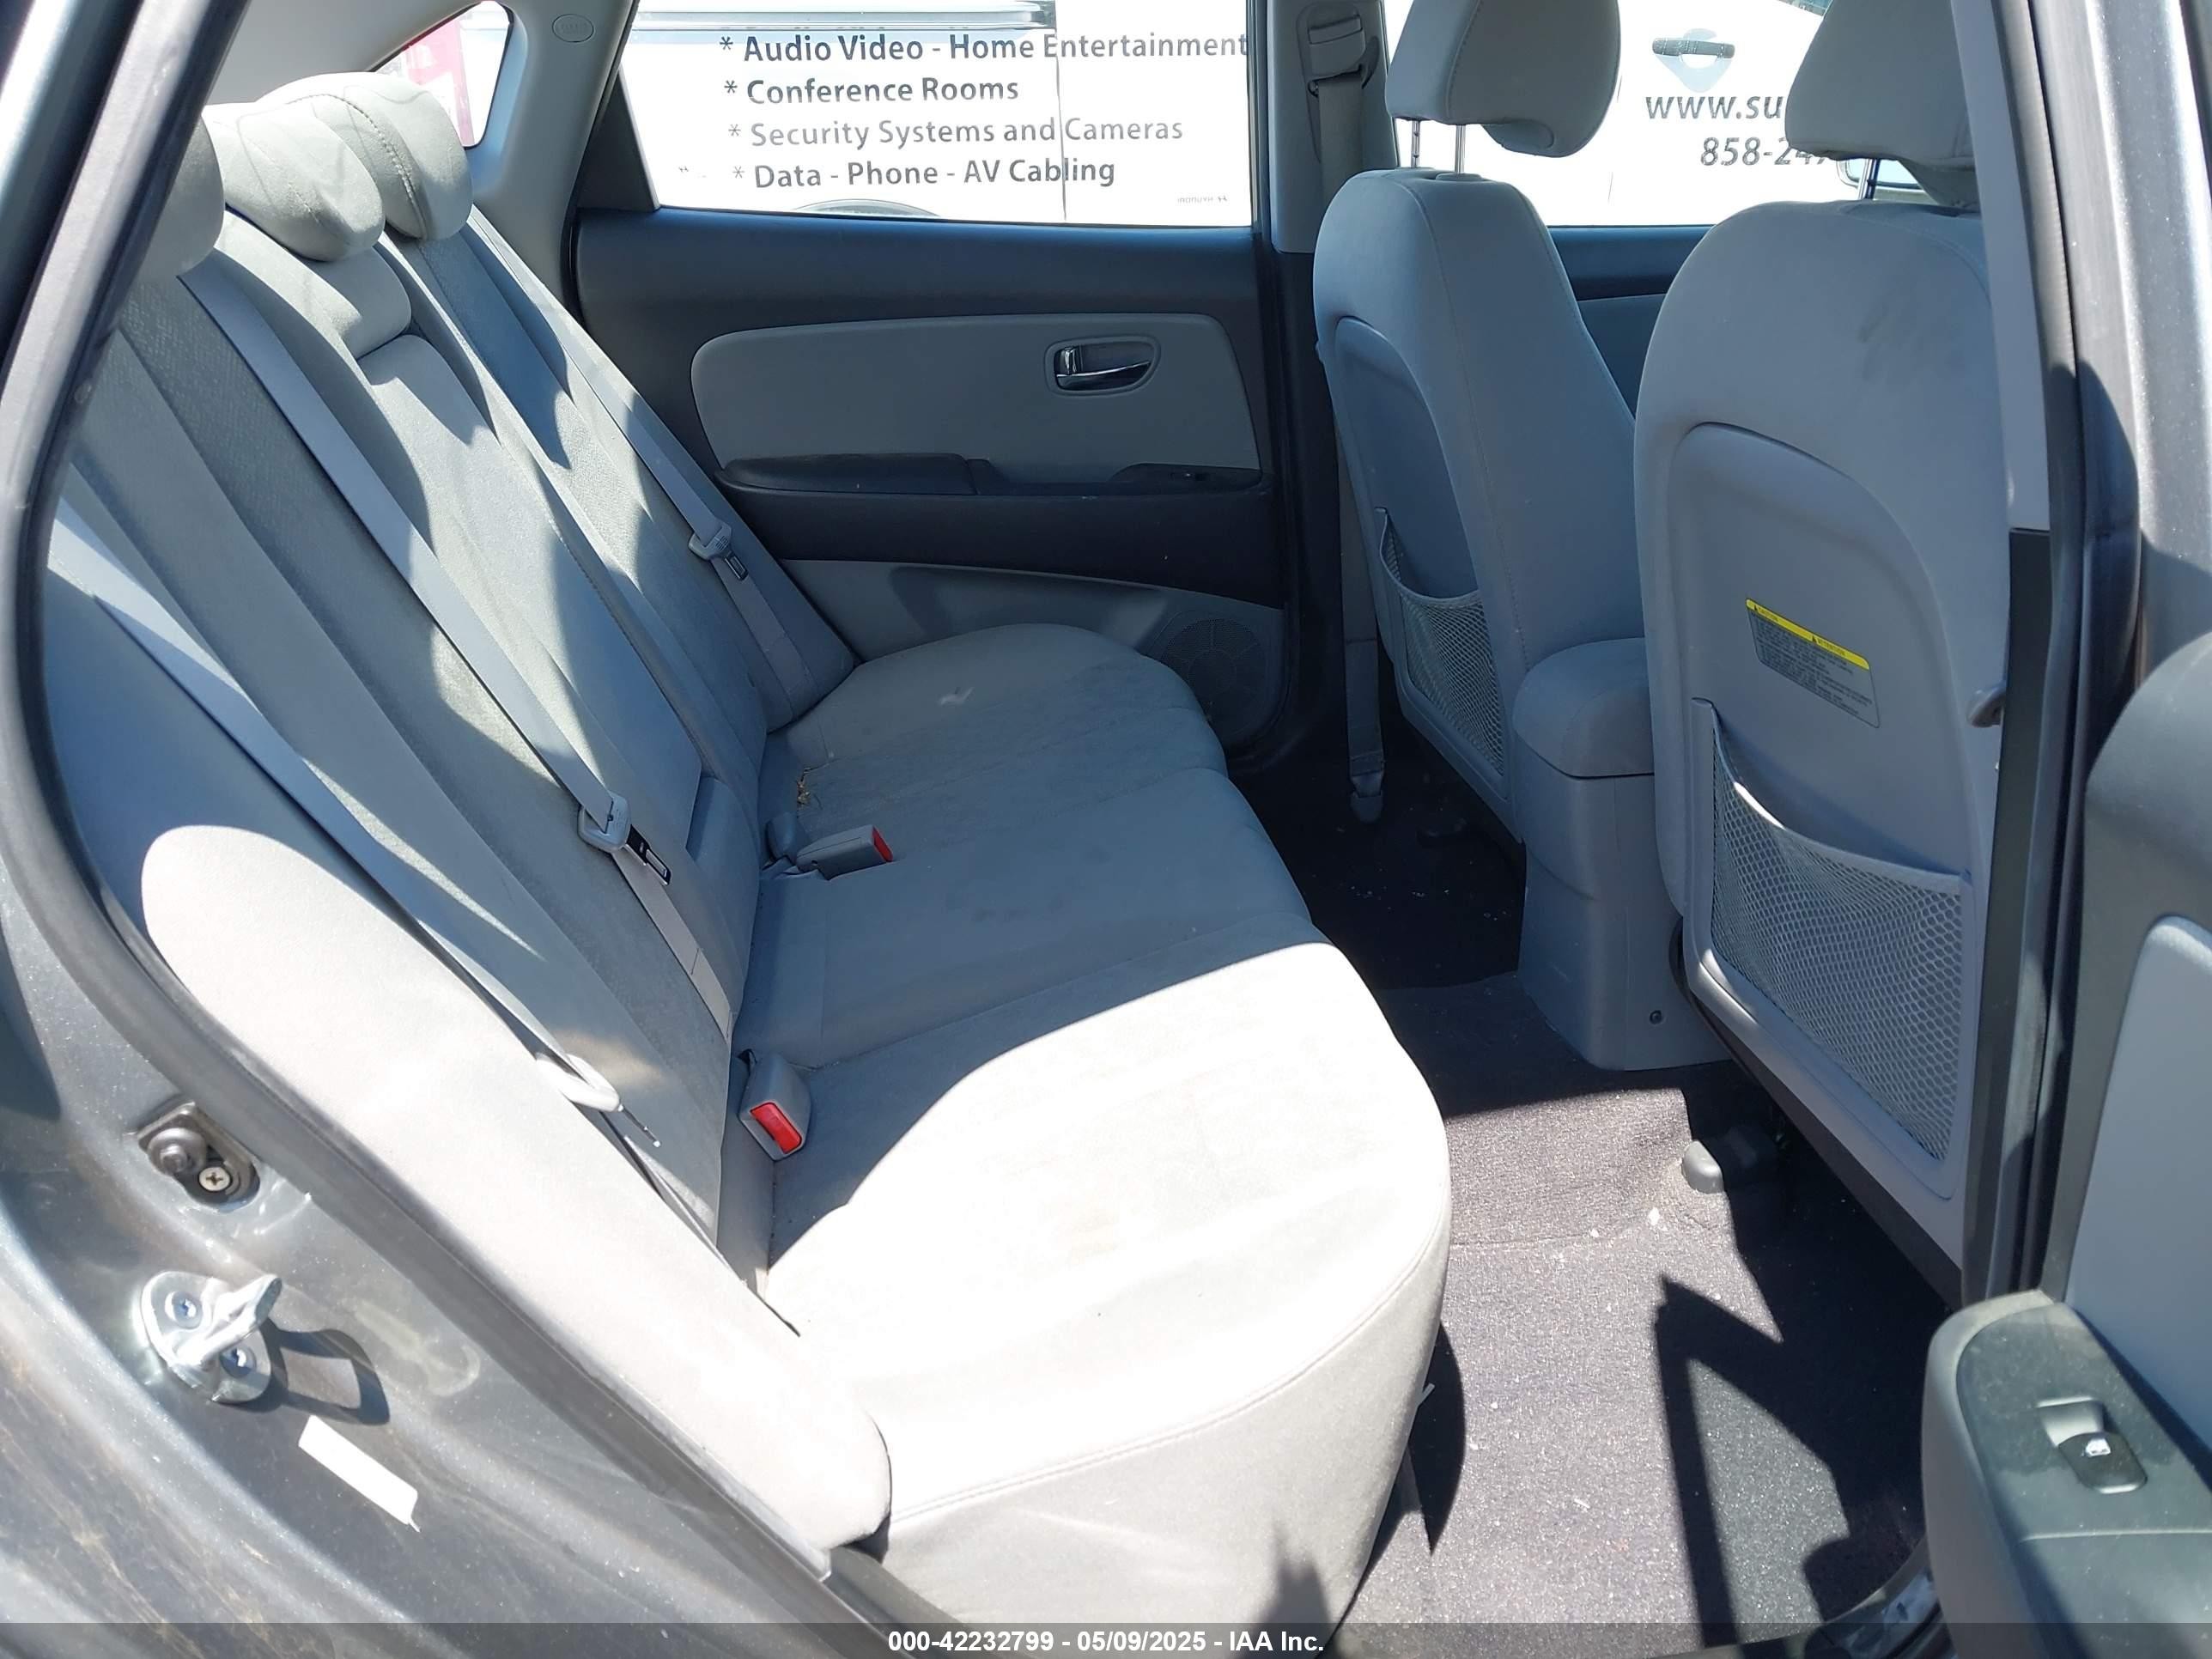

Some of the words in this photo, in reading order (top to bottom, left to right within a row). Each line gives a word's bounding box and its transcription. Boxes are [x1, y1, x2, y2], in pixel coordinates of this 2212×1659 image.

[744, 33, 831, 62] Audio
[836, 33, 924, 61] Video
[949, 33, 1035, 59] Home
[1043, 32, 1247, 58] Entertainment
[746, 77, 914, 105] Conference
[921, 76, 1018, 101] Rooms
[750, 119, 870, 151] Security
[878, 119, 995, 150] Systems
[1003, 116, 1055, 142] and
[1064, 117, 1183, 141] Cameras
[754, 164, 822, 189] Data
[848, 160, 939, 185] Phone
[963, 159, 1001, 184] AV
[1009, 156, 1115, 188] Cabling
